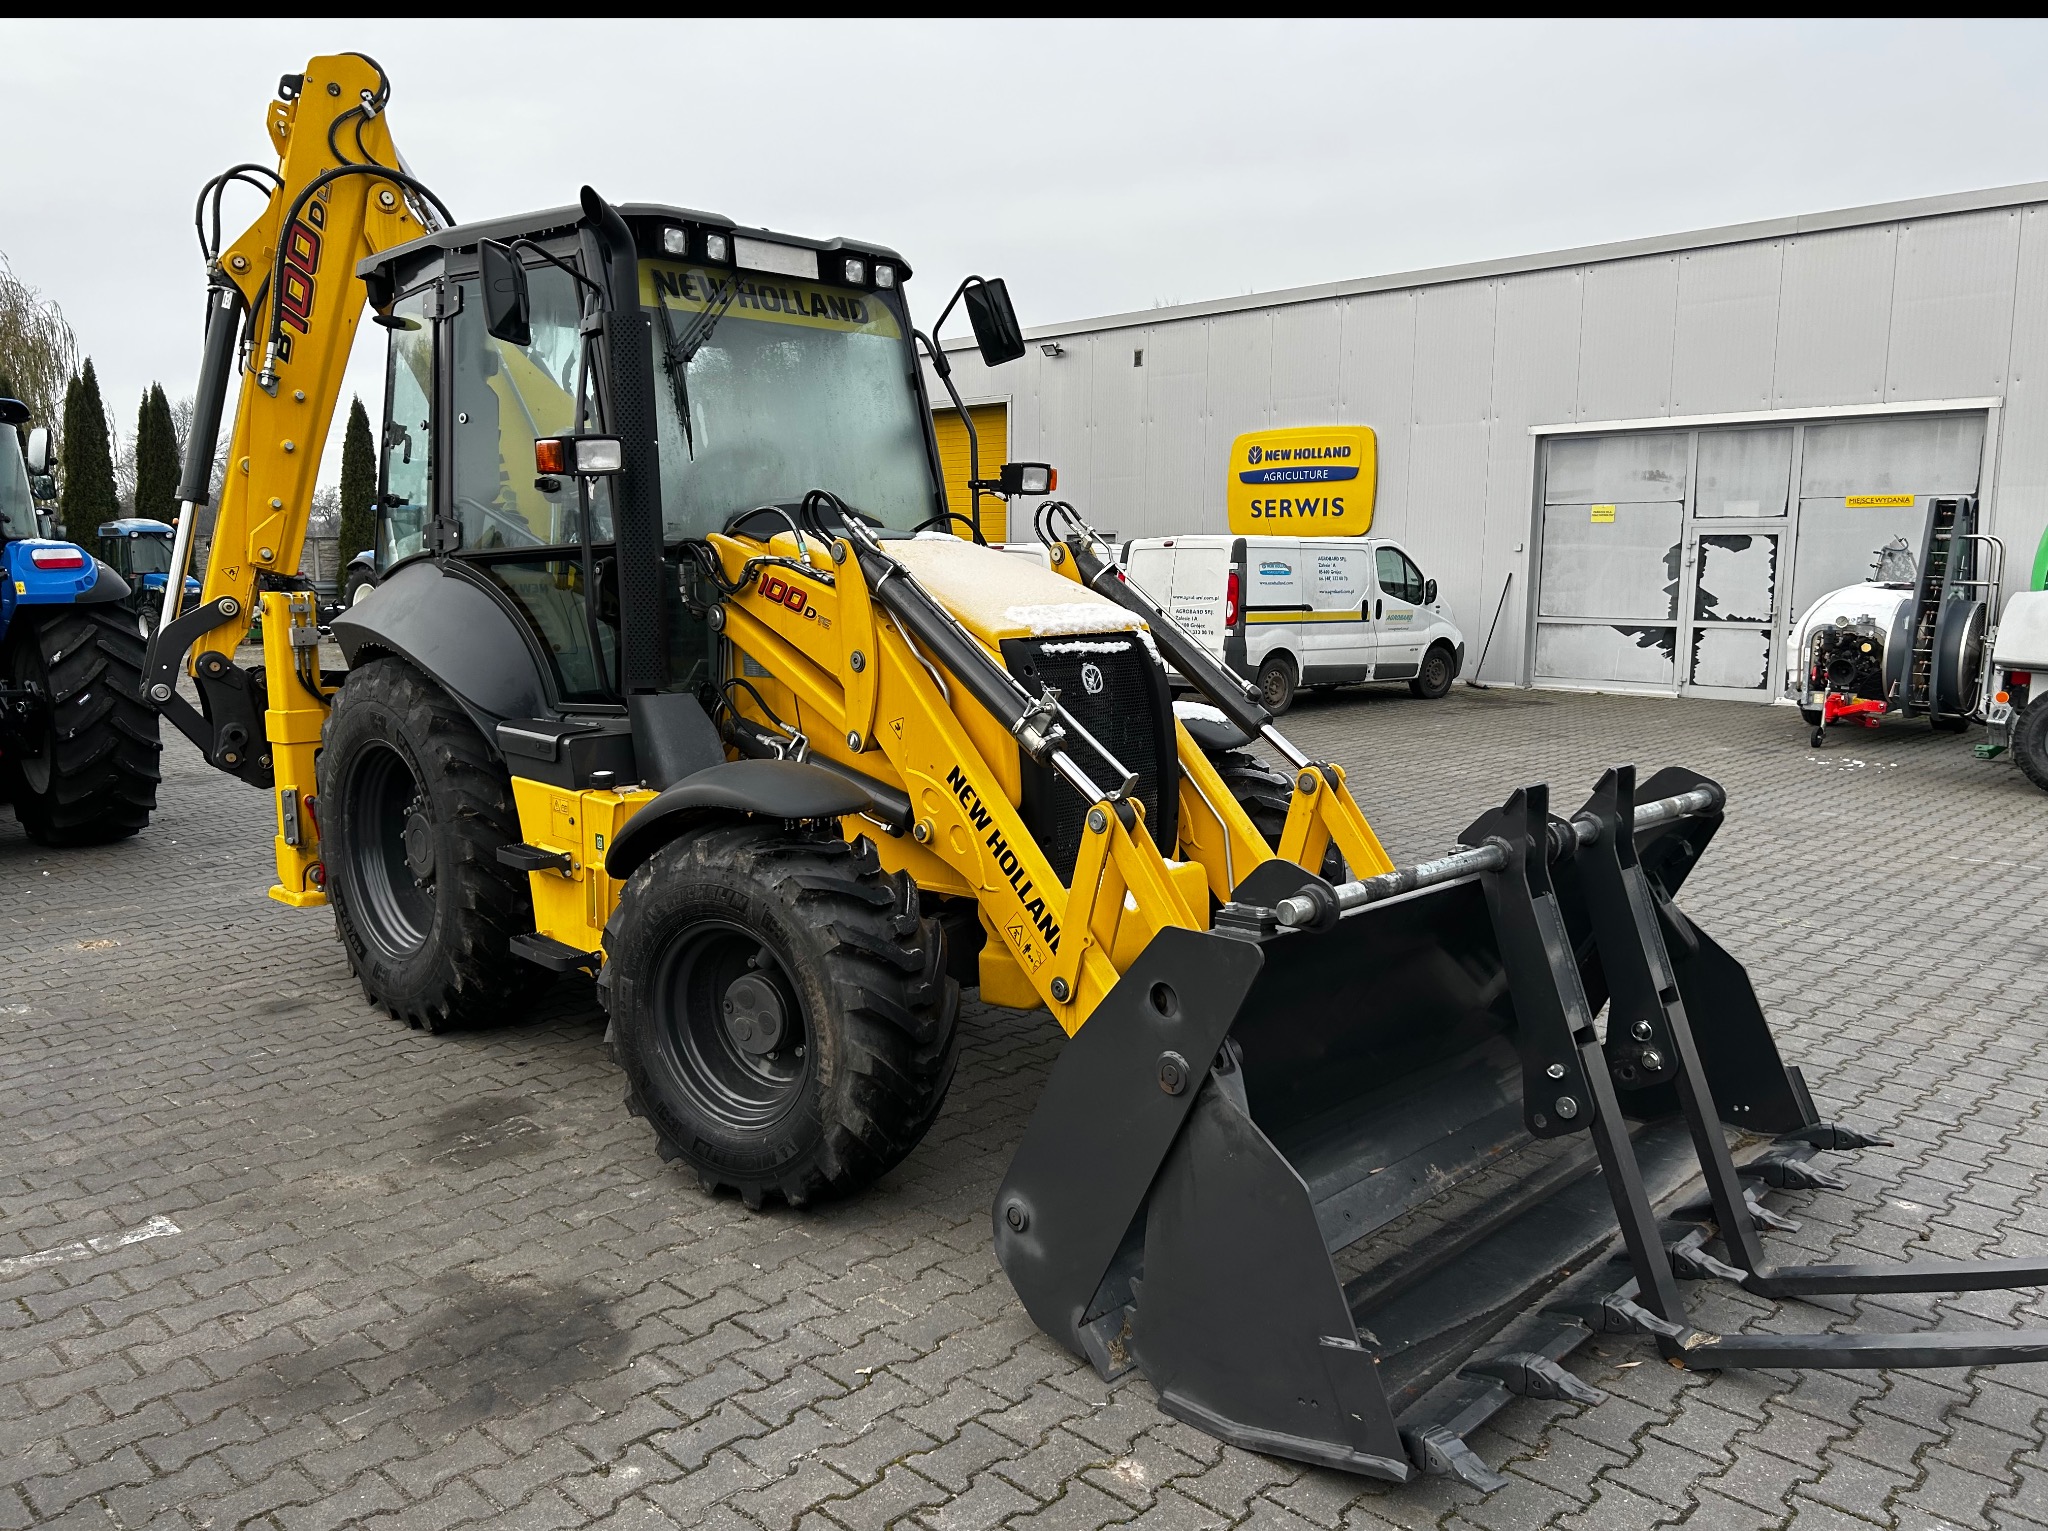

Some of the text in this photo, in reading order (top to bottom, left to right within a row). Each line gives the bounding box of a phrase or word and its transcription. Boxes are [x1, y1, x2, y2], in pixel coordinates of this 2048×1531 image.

[651, 268, 869, 324] NEW HOLLAND
[1264, 446, 1351, 461] NEW HOLLAND
[1263, 469, 1329, 481] AGRICULTURE
[1250, 497, 1344, 518] SERWIS
[946, 765, 992, 832] NEW
